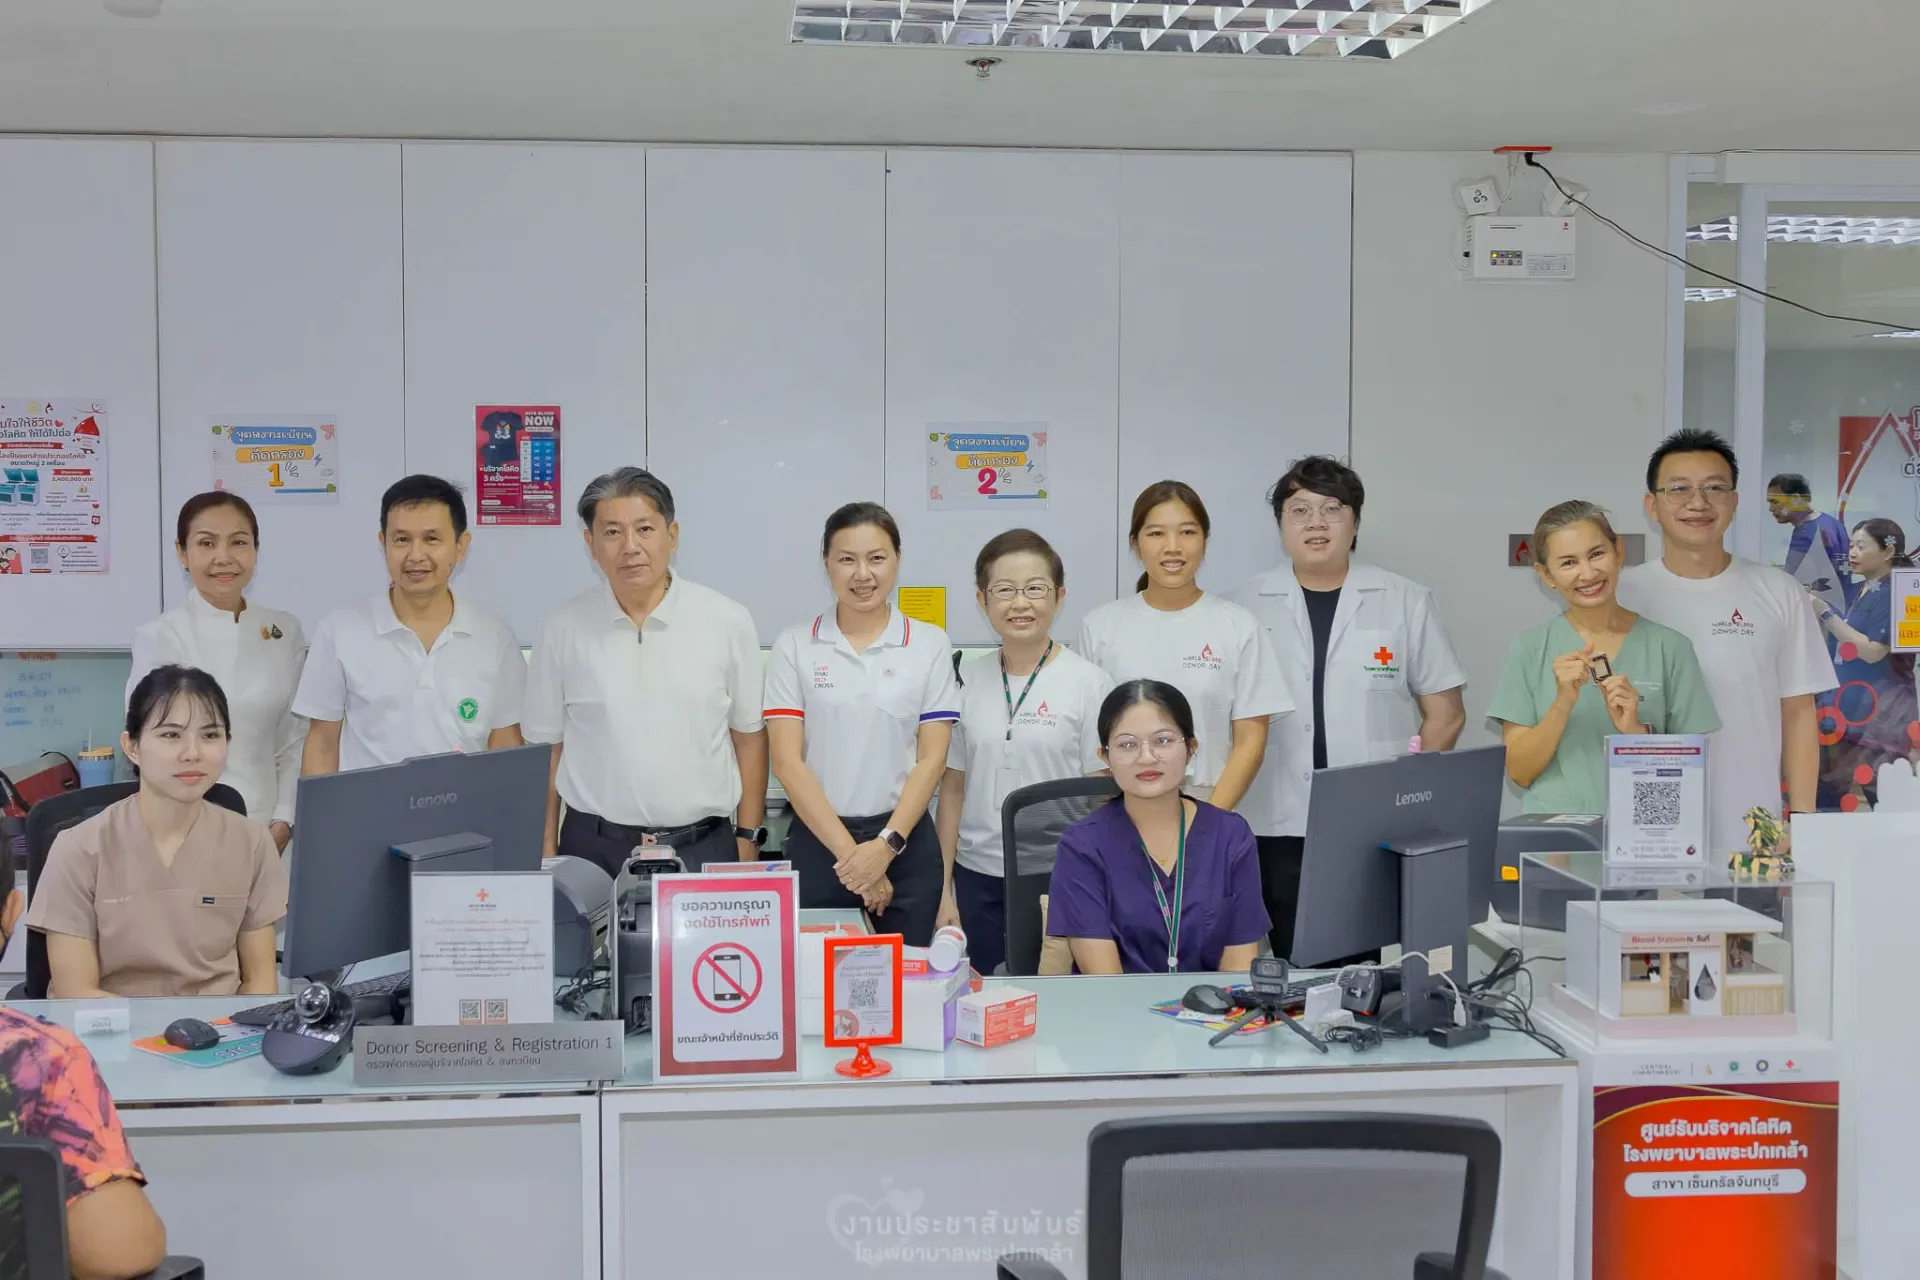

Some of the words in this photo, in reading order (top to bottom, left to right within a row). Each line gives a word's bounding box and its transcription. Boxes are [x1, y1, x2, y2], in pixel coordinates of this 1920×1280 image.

[525, 416, 554, 426] NOW
[237, 429, 313, 443] จุดลงทะเบียน
[953, 436, 1026, 450] จุดลงทะเบียน
[250, 447, 305, 461] คัดกรอง
[967, 454, 1019, 467] คัดกรอง
[268, 463, 284, 487] 1
[977, 467, 998, 494] 2
[1712, 628, 1739, 636] DONOR
[1740, 628, 1756, 637] DAY
[1208, 663, 1222, 671] DAY
[1042, 720, 1058, 728] DAY
[409, 792, 458, 810] Lenovo
[1395, 790, 1433, 806] Lenovo
[681, 900, 771, 914] ขอความกรุณา
[684, 914, 770, 929] งดใช้โทรศัพท์
[677, 1029, 779, 1044] ขณะเจ้าหน้าที่ซักประวัติ
[366, 1041, 410, 1055] Donor
[415, 1039, 488, 1055] Screening
[494, 1037, 505, 1052] &
[512, 1036, 599, 1054] Registration
[605, 1036, 613, 1049] 1
[487, 1056, 495, 1066] &
[1640, 1116, 1792, 1143] ศูนย์รับบริจาคโลหิต
[1622, 1140, 1809, 1163] โรงพยาบาลพระปกเกล้า
[1652, 1177, 1684, 1191] สาขา
[1687, 1173, 1780, 1192] เซ็นทรัลจันทบุรี
